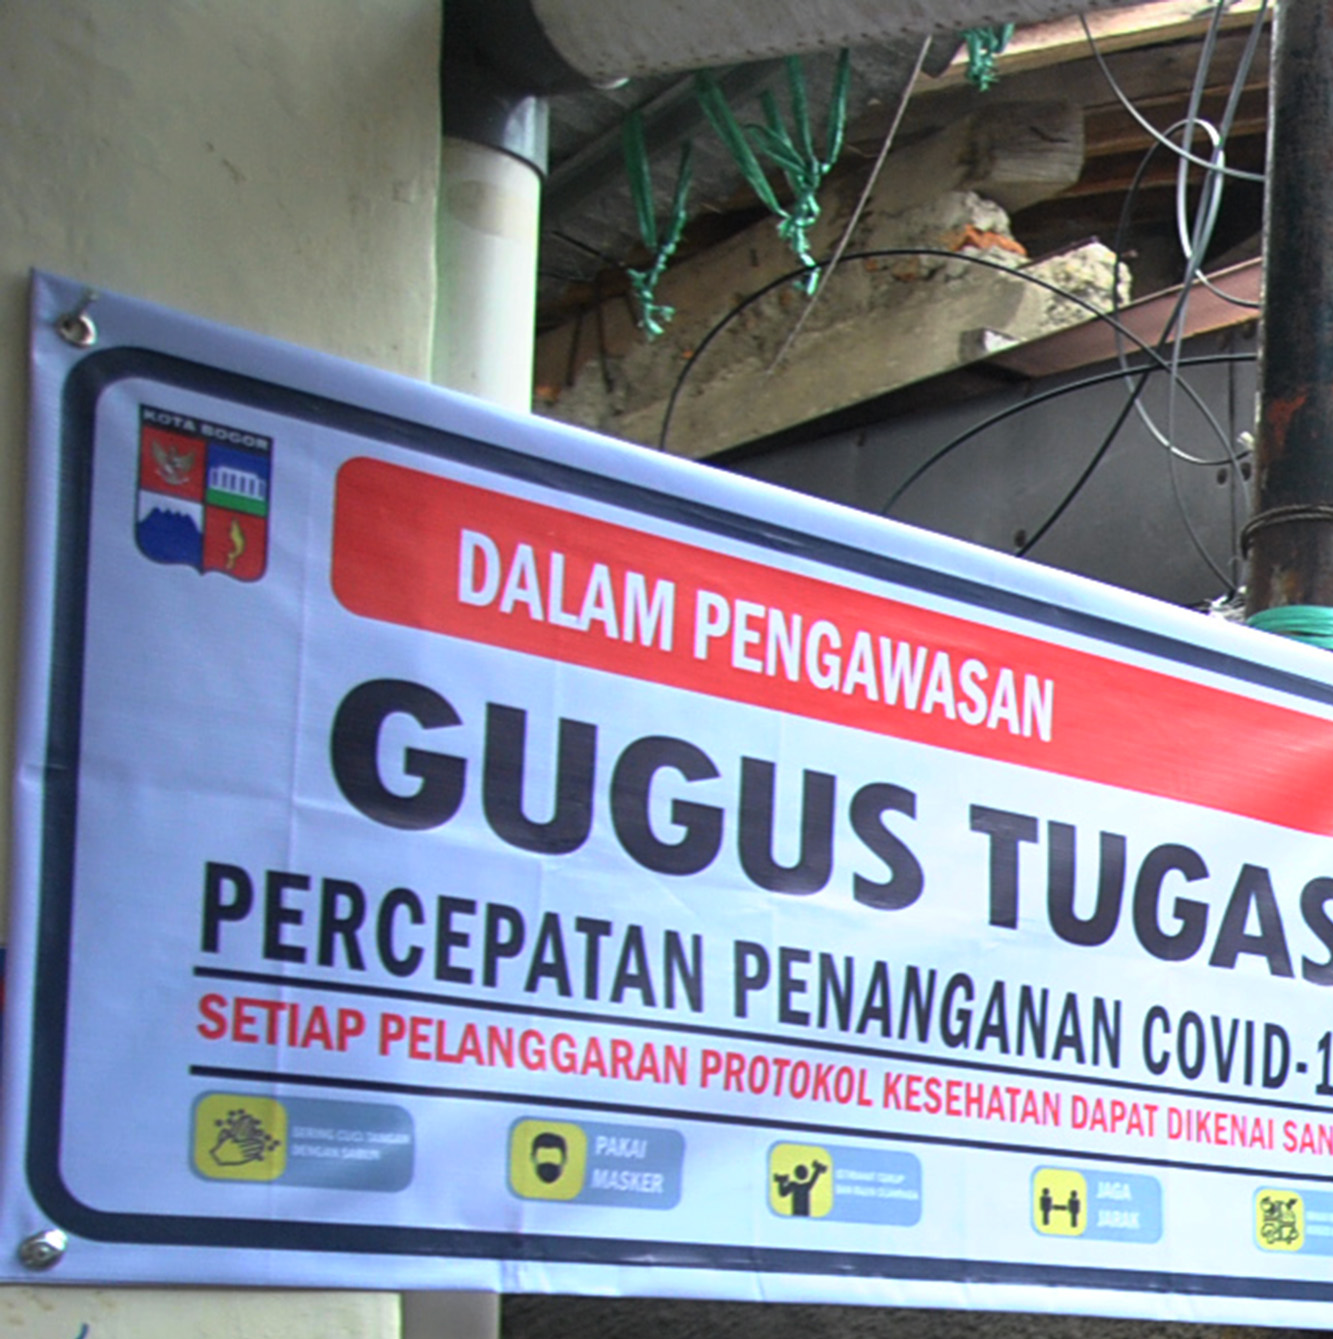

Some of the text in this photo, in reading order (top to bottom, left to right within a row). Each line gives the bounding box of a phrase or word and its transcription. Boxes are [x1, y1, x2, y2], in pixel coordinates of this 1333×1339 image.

[143, 409, 270, 450] KOTA BOGOR
[457, 528, 1056, 743] DALAM PENGAWASAN
[329, 677, 925, 911] GUGUS
[200, 860, 705, 1015] PERCEPATAN
[733, 940, 1123, 1070] PENANGANAN
[197, 992, 366, 1053] SETIAP
[379, 1014, 689, 1087] PELANGGARAN
[700, 1048, 873, 1109] PROTOKOL
[882, 1072, 1063, 1128] KESEHATAN
[1070, 1092, 1160, 1140] DAPAT
[1166, 1107, 1276, 1152] DIKENAI
[594, 1135, 648, 1160] PAKAI
[590, 1168, 665, 1195] MASKER
[1095, 1180, 1133, 1202] JAGA
[1096, 1208, 1142, 1231] JARAK
